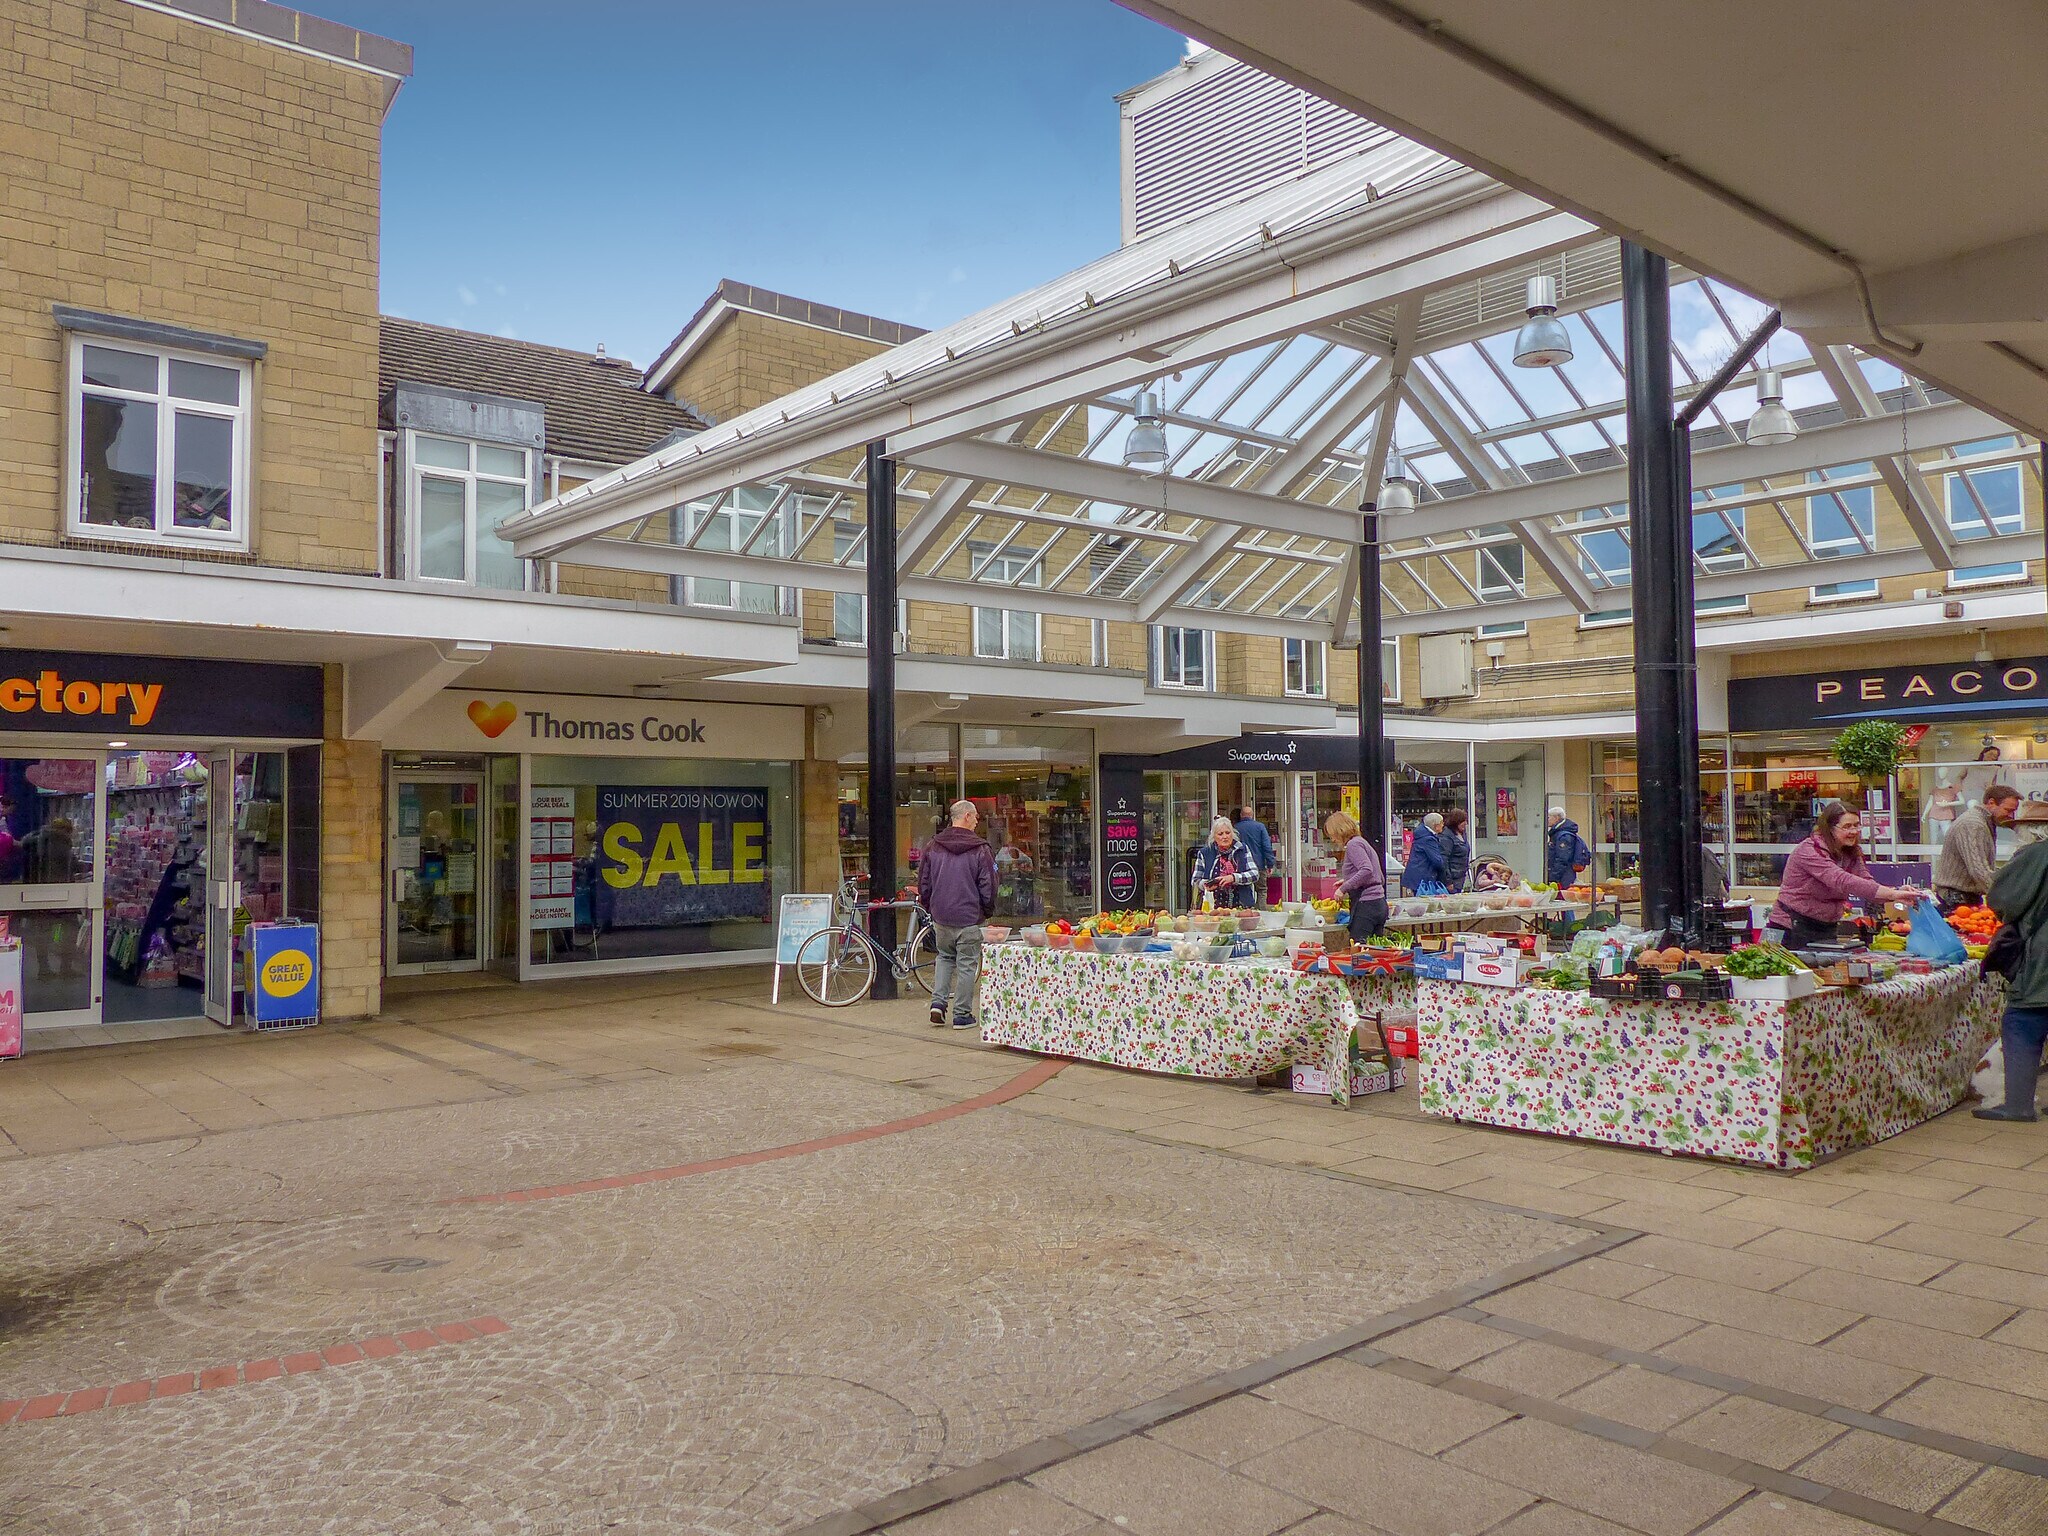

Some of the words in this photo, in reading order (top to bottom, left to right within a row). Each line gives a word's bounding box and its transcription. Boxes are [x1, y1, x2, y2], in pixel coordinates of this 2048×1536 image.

[0, 670, 164, 726] ctory
[525, 711, 635, 741] Thomas
[641, 716, 706, 743] Cook
[1227, 748, 1293, 765] Superdrug
[1790, 771, 1814, 781] sale
[603, 793, 668, 808] SUMMER
[670, 794, 701, 808] 2019
[703, 794, 740, 808] NOW
[741, 794, 764, 808] ON
[1106, 809, 1137, 817] Superdrug
[1107, 825, 1137, 838] save
[1107, 839, 1138, 852] more
[601, 821, 765, 889] SALE
[782, 927, 808, 936] NOW
[268, 964, 305, 974] GREAT
[269, 973, 305, 983] VALUE
